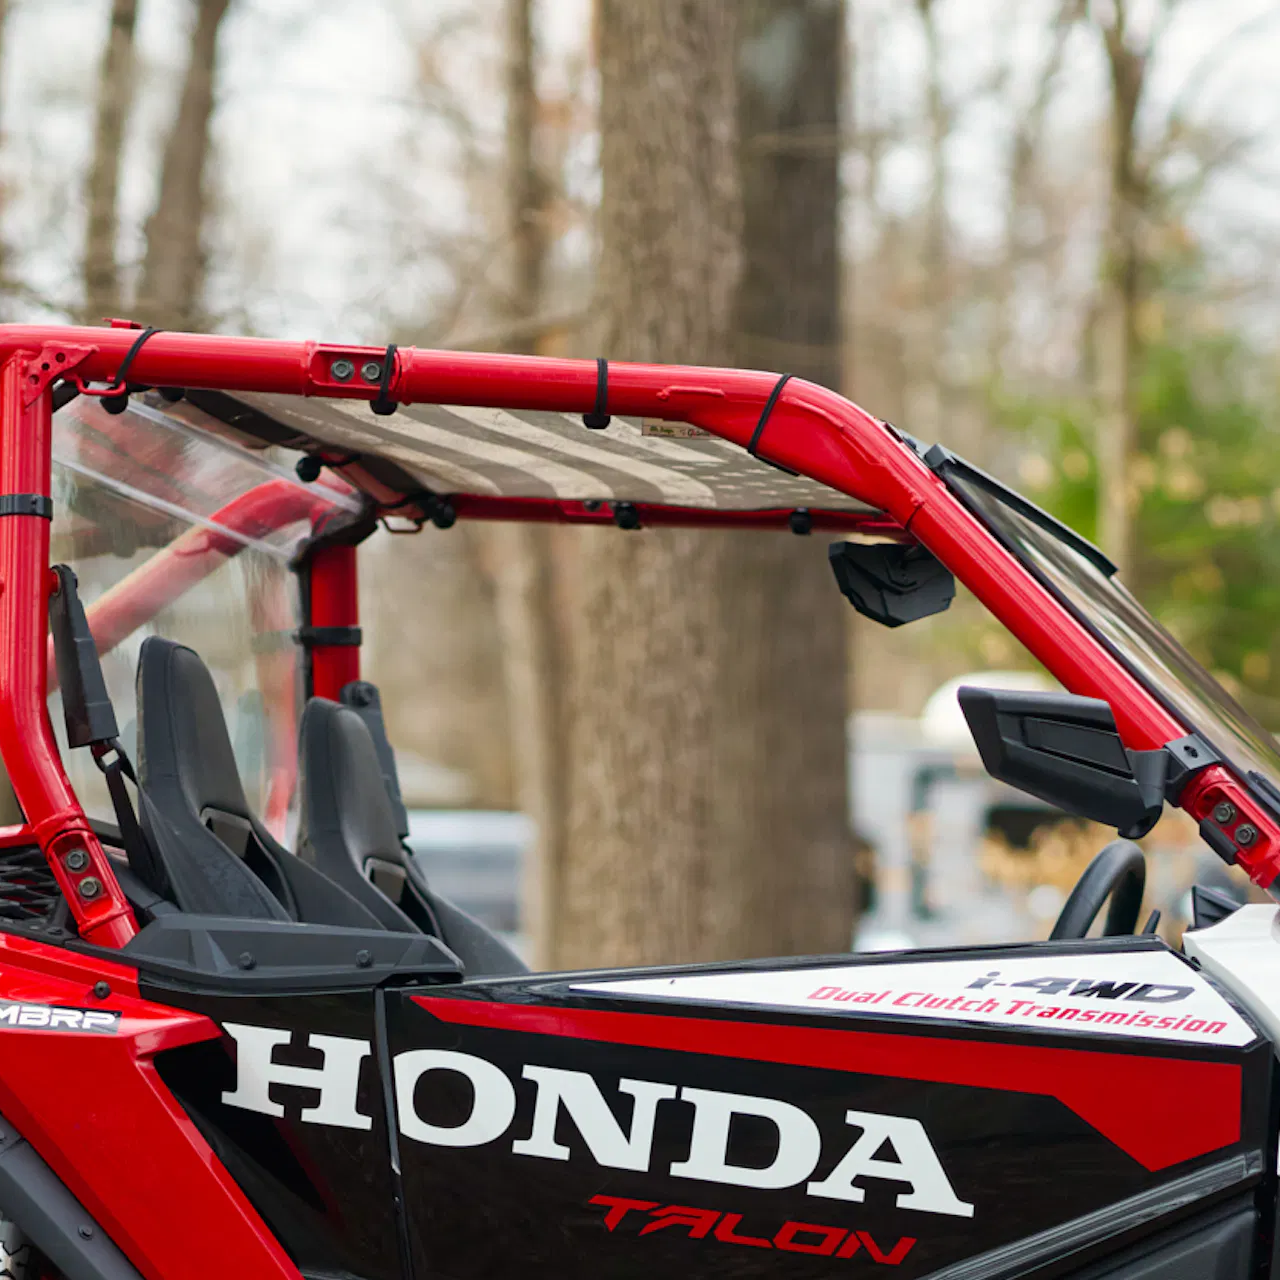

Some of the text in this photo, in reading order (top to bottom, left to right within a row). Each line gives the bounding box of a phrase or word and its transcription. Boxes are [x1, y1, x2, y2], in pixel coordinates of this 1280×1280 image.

[807, 986, 1228, 1034] Dual Clutch Transmission
[964, 971, 1195, 1003] i-4WD
[220, 1021, 975, 1218] HONDA
[588, 1193, 917, 1266] TALON
